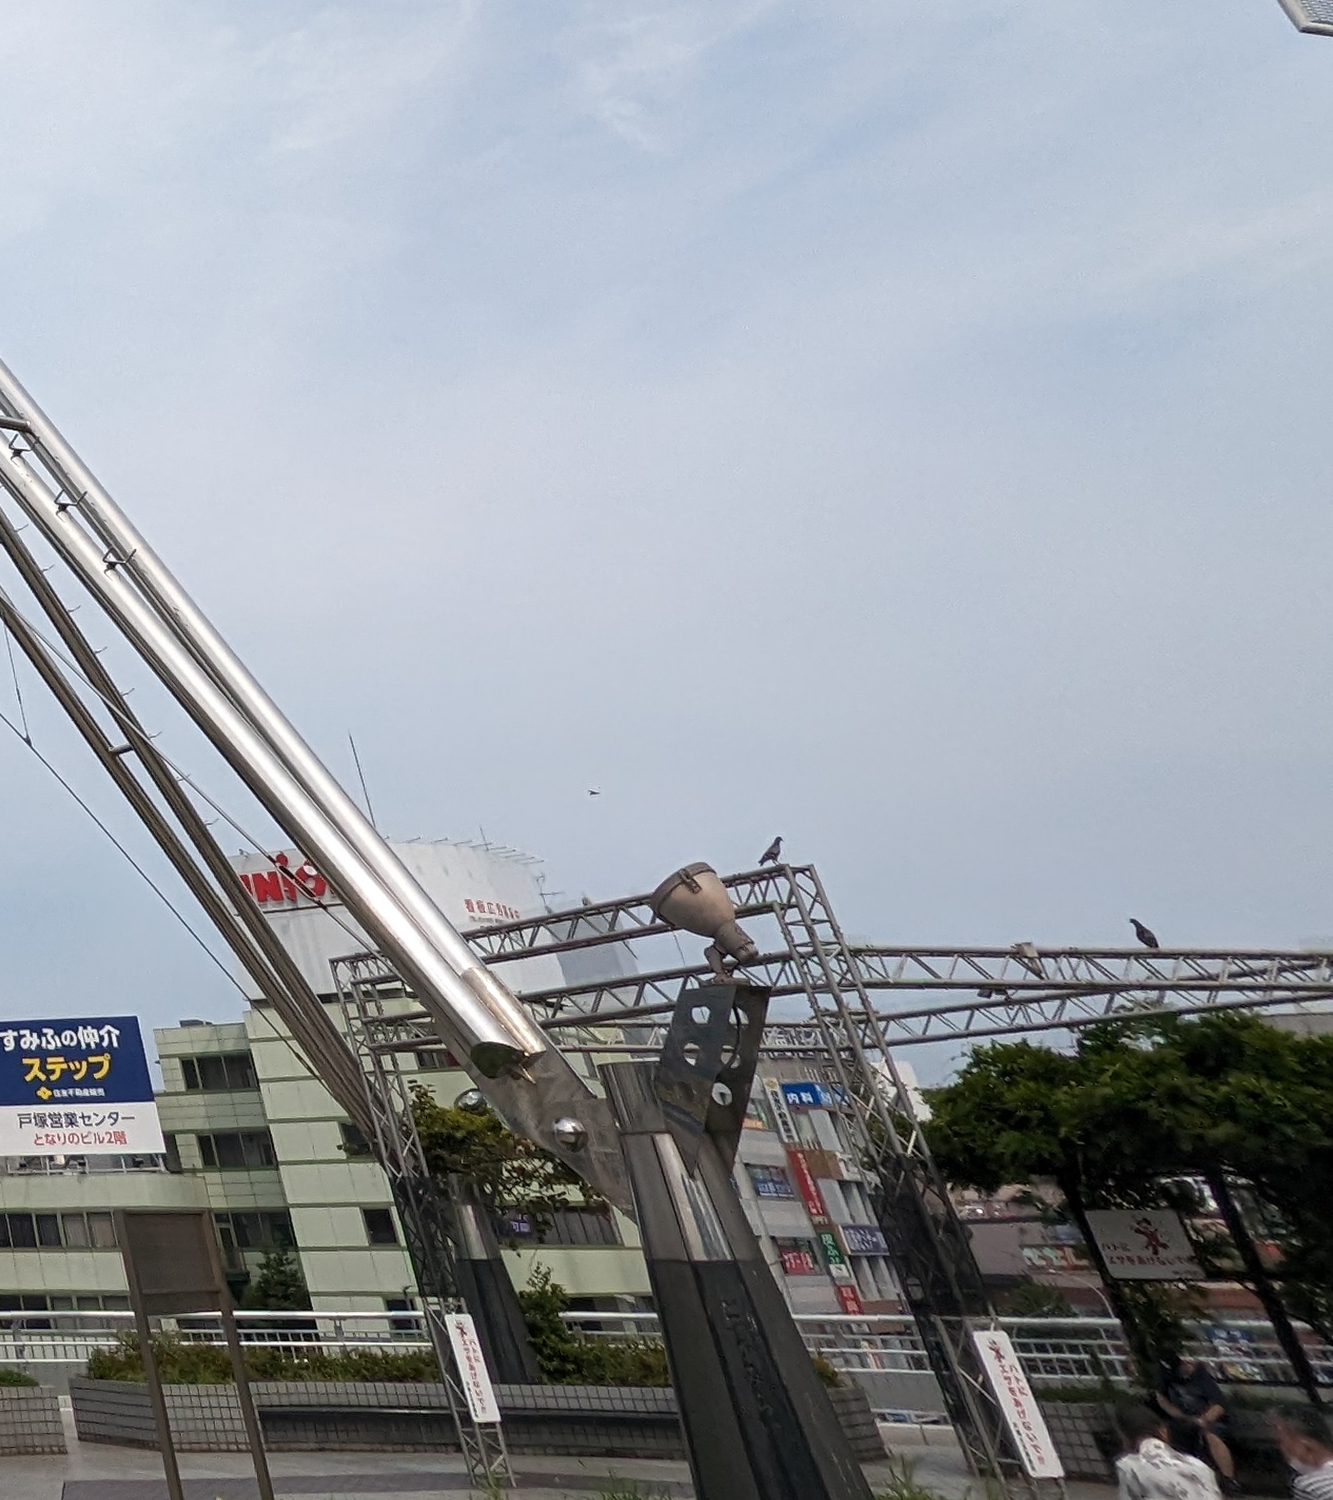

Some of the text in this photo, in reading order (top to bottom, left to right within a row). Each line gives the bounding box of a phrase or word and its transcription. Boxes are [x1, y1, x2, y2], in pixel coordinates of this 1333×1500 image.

[21, 1053, 111, 1082] ステップ
[53, 1088, 106, 1097] 住友不動産販売
[786, 1092, 813, 1104] 内科
[17, 1111, 136, 1128] 戸塚営業センター
[34, 1130, 128, 1145] となりのビル2階
